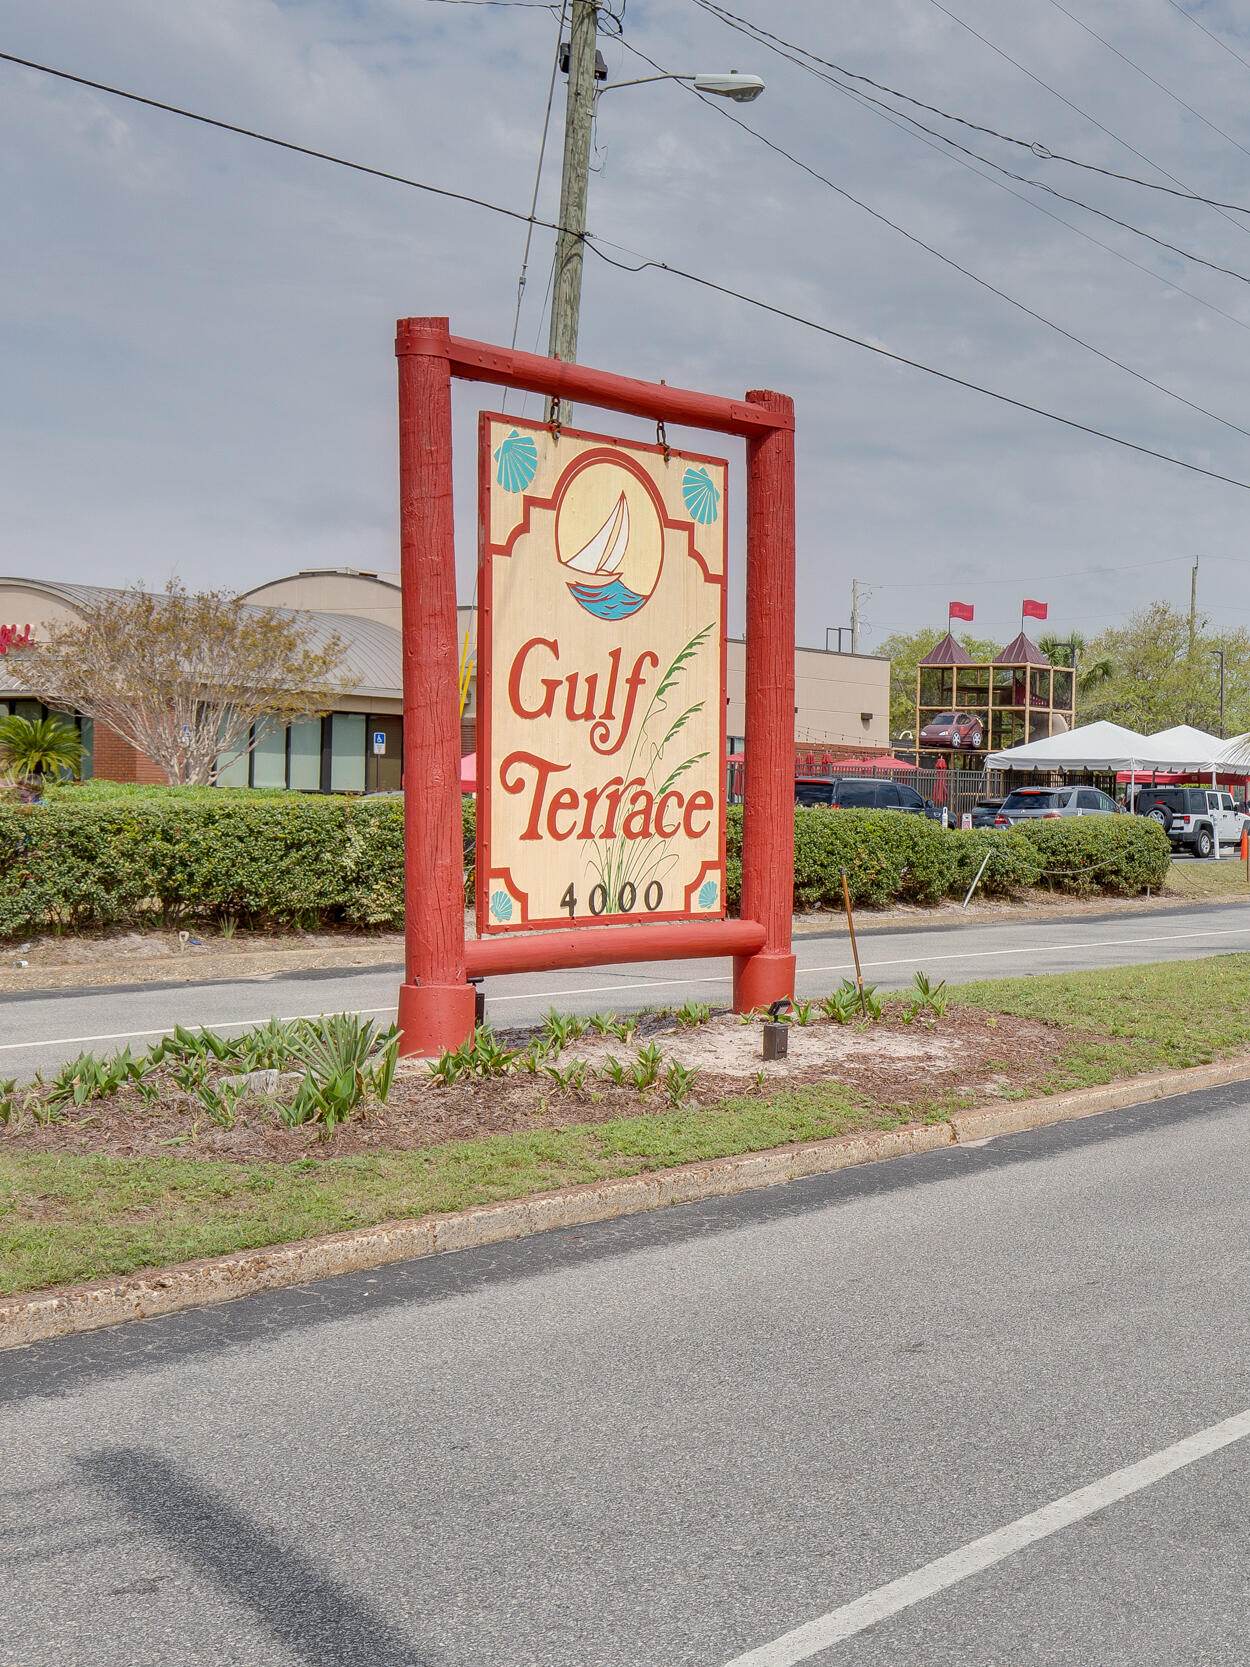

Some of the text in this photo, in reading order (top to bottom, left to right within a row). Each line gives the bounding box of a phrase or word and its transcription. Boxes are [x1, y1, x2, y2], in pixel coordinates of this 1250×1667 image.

[508, 637, 659, 755] Gulf
[500, 751, 714, 842] Terrace
[560, 880, 663, 917] 4000
